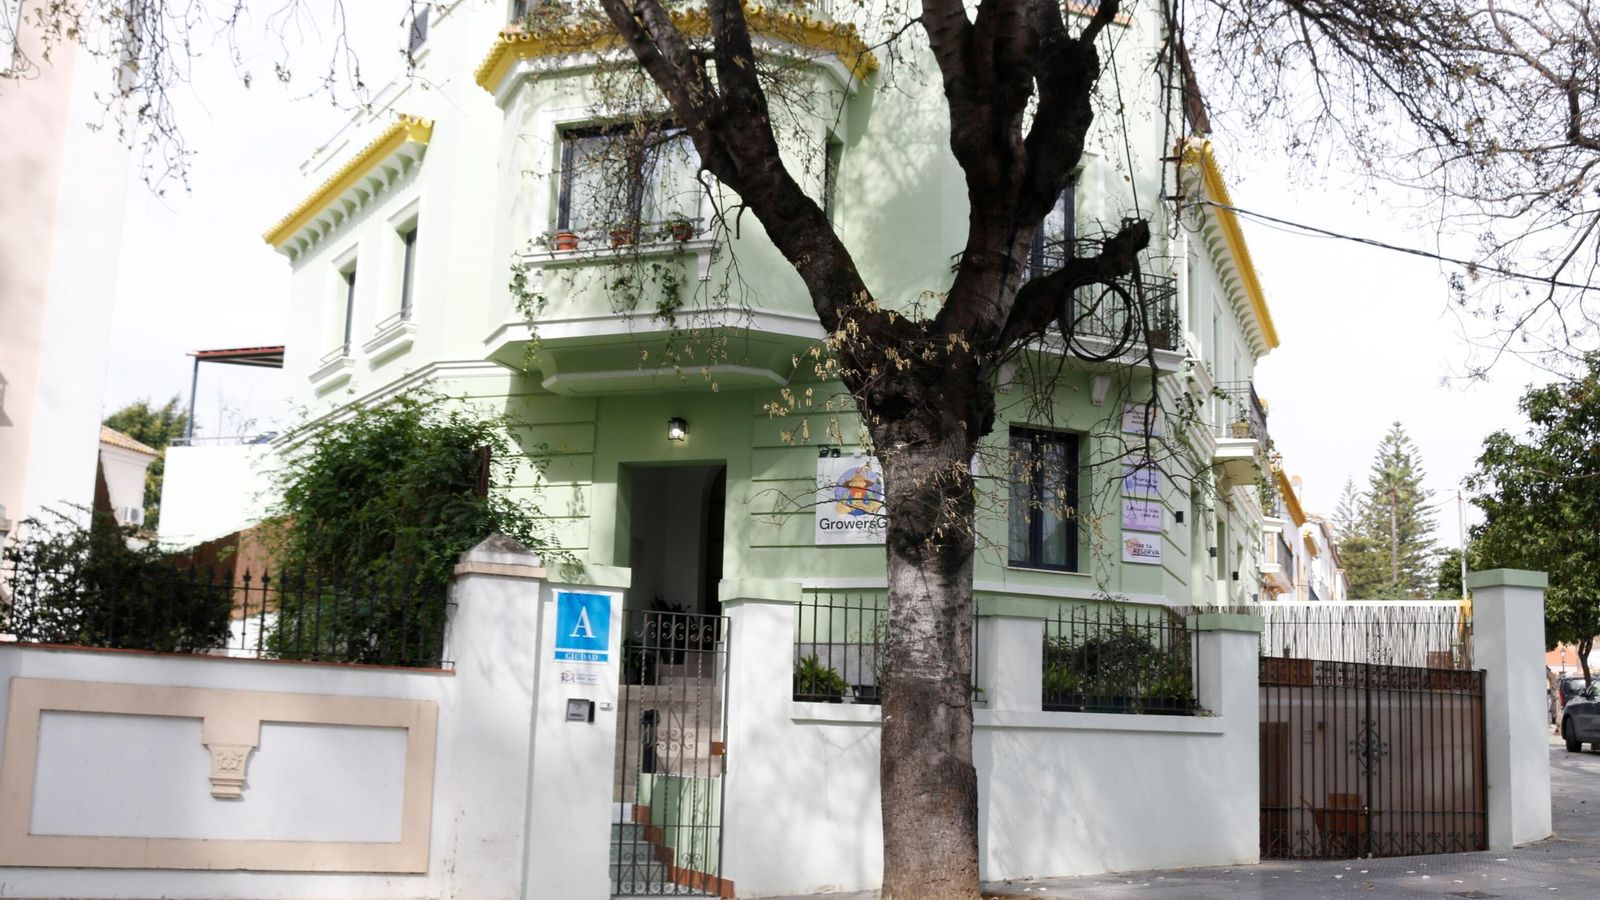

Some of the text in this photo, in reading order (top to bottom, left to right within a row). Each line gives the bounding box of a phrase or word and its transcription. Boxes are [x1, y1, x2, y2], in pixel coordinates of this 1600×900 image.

[819, 517, 887, 530] GrowersG
[569, 606, 596, 638] A
[565, 652, 599, 661] CIUDAD
